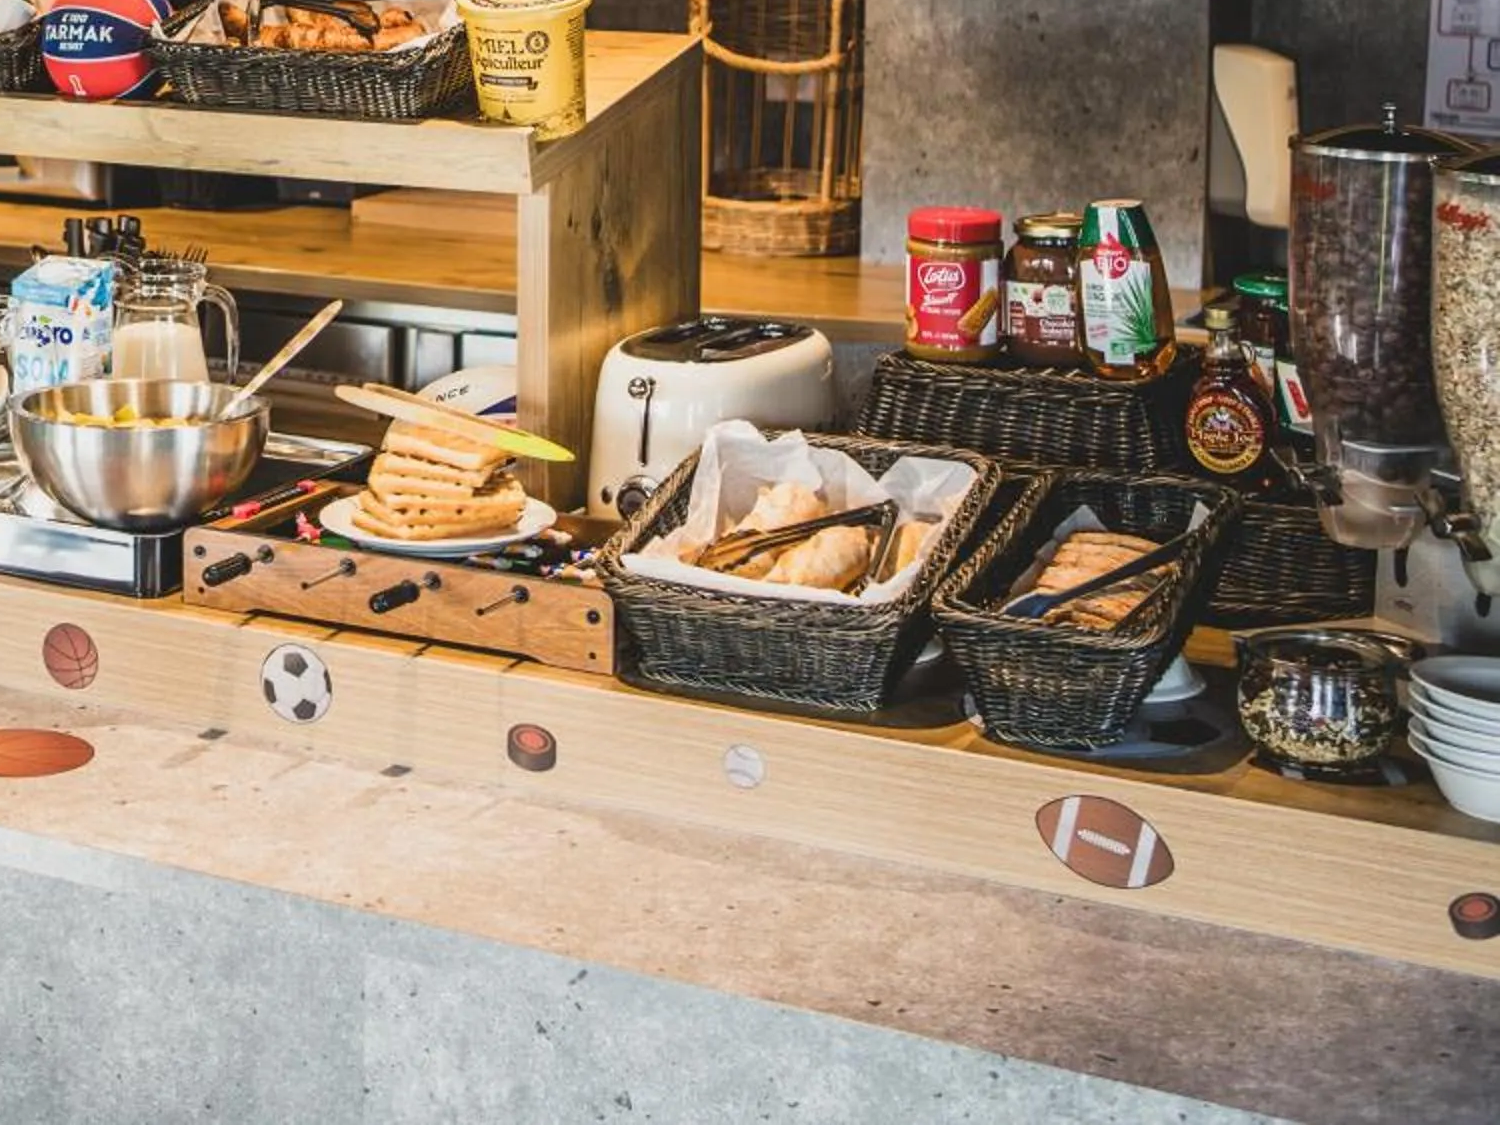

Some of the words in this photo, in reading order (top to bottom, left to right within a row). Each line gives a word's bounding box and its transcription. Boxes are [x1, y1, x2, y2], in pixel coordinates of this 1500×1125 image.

[45, 24, 114, 43] TARMAK
[476, 36, 525, 55] MIEL
[923, 266, 959, 284] Lotus
